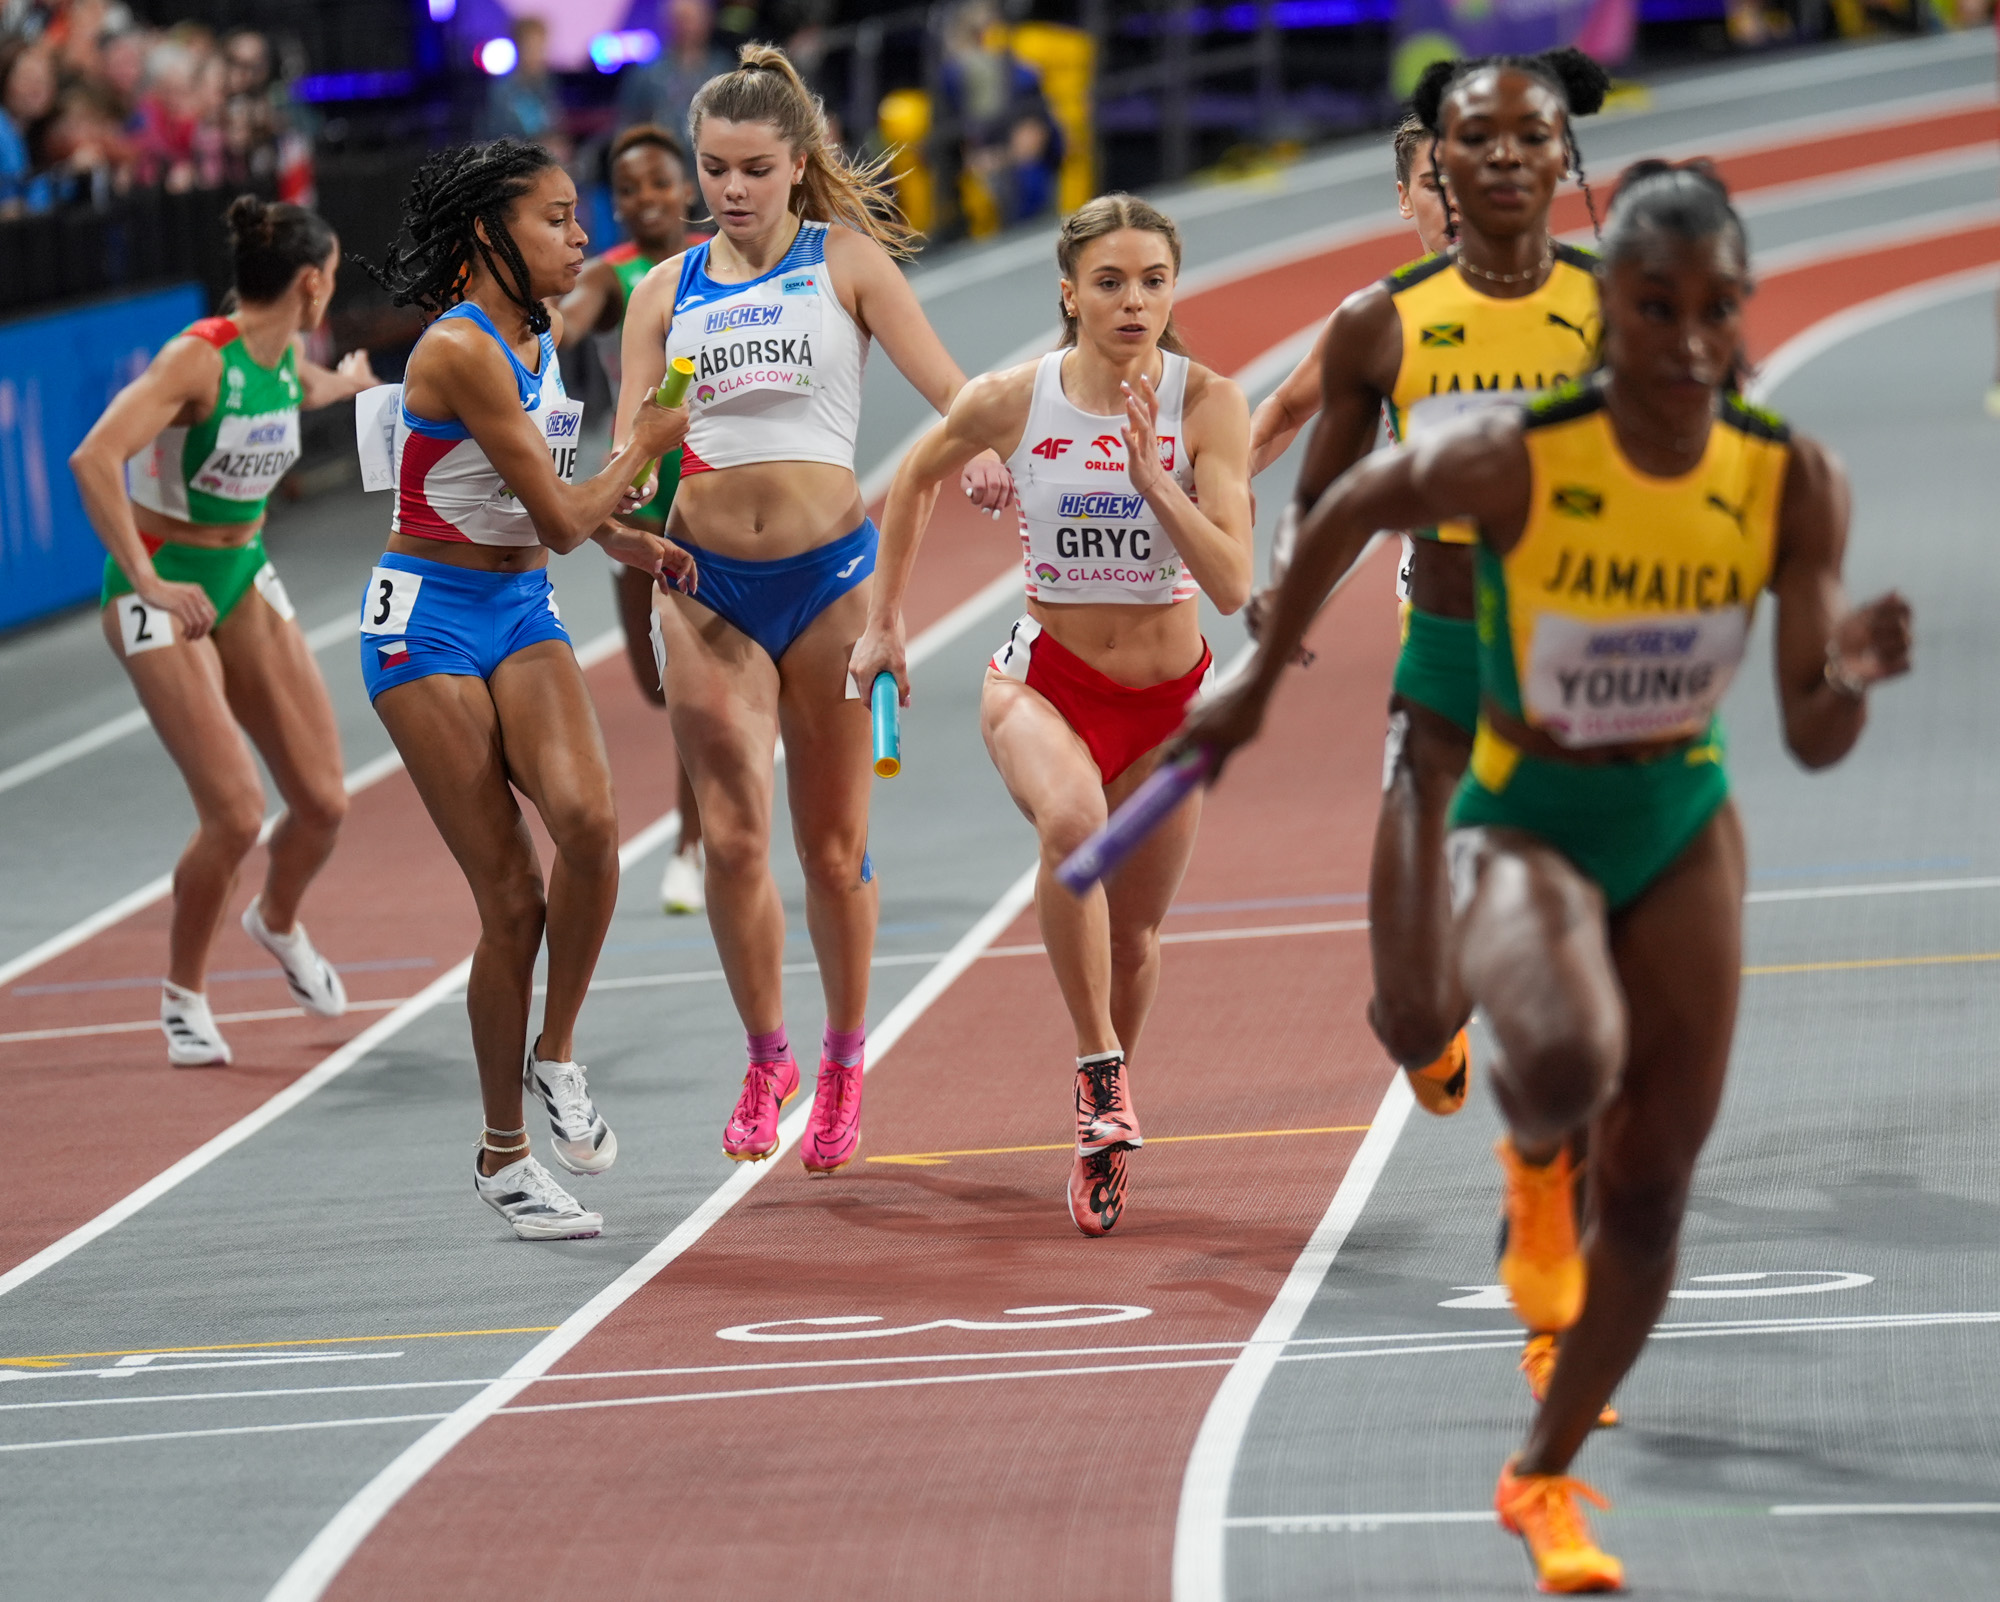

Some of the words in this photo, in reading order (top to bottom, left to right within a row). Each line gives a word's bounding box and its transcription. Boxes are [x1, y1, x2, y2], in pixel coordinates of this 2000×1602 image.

[704, 304, 783, 334] HI-CHEW
[718, 370, 794, 394] GLASGOW
[796, 373, 810, 387] 24
[1032, 437, 1073, 460] 4F
[1085, 460, 1125, 472] ORLEN
[1057, 492, 1146, 520] HI-CHEW
[1056, 527, 1151, 561] GRYC
[1067, 568, 1156, 583] GLASGOW
[1159, 565, 1176, 581] 24
[1543, 549, 1742, 611] JAMAICA
[373, 579, 394, 625] 3
[130, 604, 152, 643] 2
[1556, 663, 1714, 709] YOUNG
